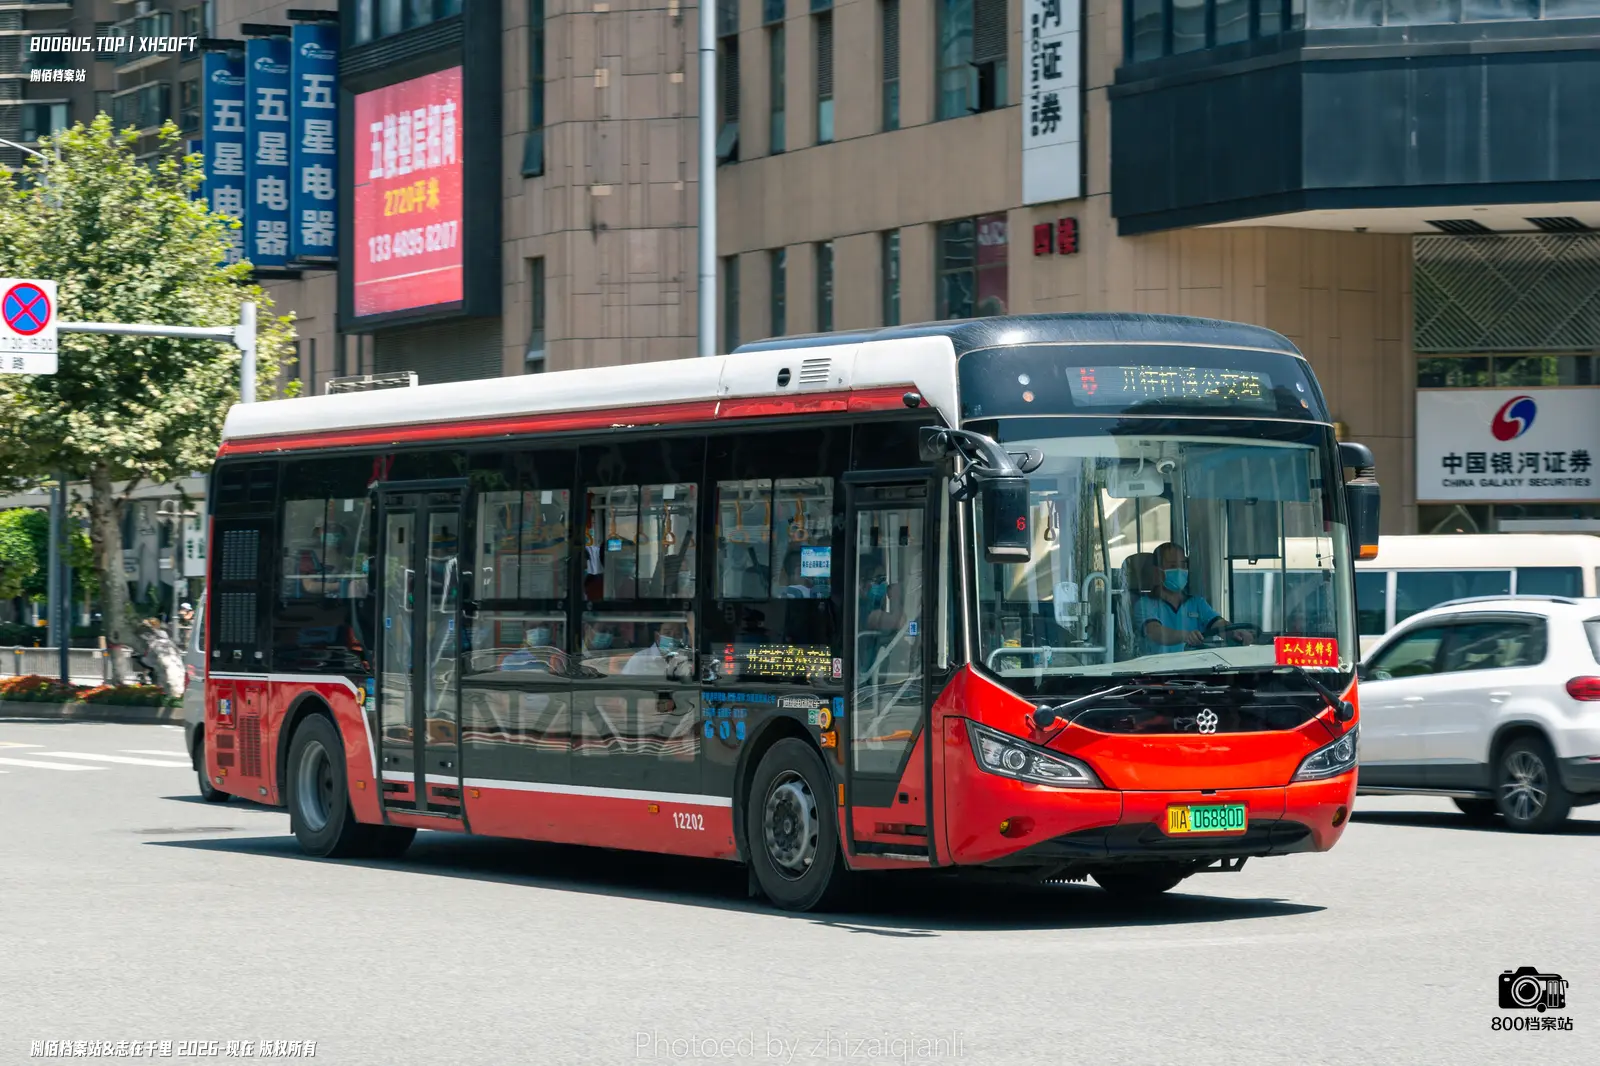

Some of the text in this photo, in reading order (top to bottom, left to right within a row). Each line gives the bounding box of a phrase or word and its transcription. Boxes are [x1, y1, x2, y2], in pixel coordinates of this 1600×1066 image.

[301, 73, 335, 247] 五星电器
[255, 87, 289, 257] 五星电器
[1442, 449, 1592, 475] 中国银河证券
[1442, 477, 1592, 488] CHINA GALAXY SECURITIES
[1016, 516, 1026, 531] 6
[1283, 641, 1332, 656] 工人先锋号
[673, 812, 705, 831] 12202
